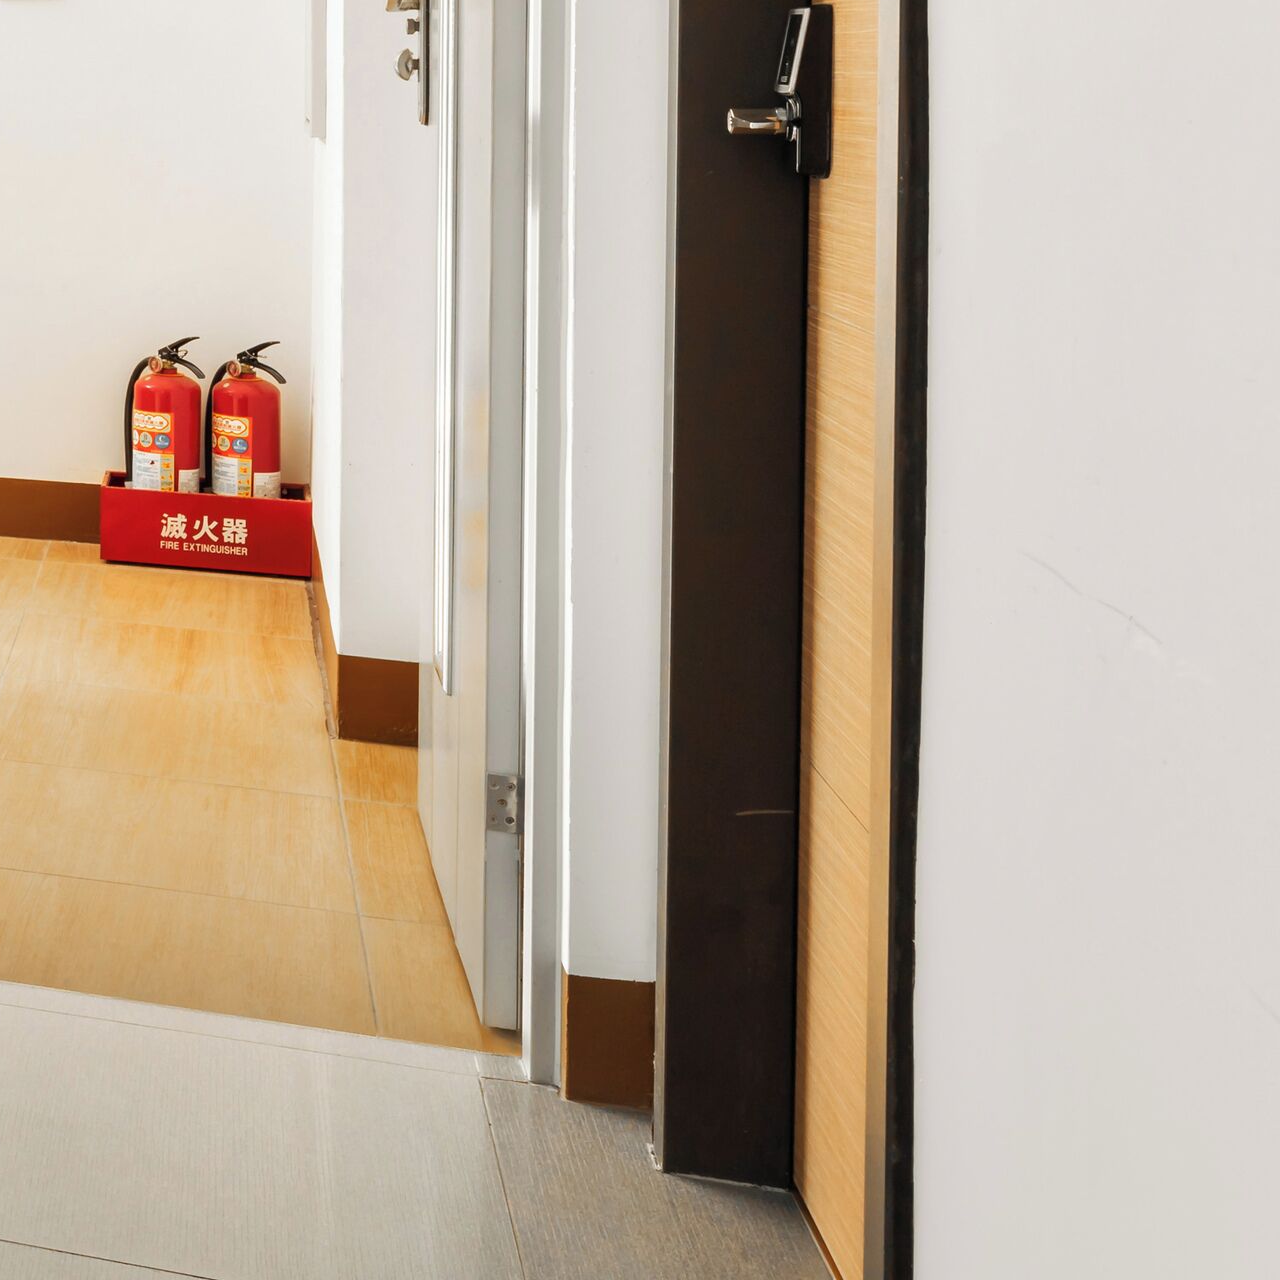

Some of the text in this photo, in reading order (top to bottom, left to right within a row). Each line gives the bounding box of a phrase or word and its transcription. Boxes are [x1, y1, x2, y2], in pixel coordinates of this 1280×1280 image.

[160, 513, 248, 544] 滅火器
[160, 540, 248, 556] FIRE EXTINGUISHER
